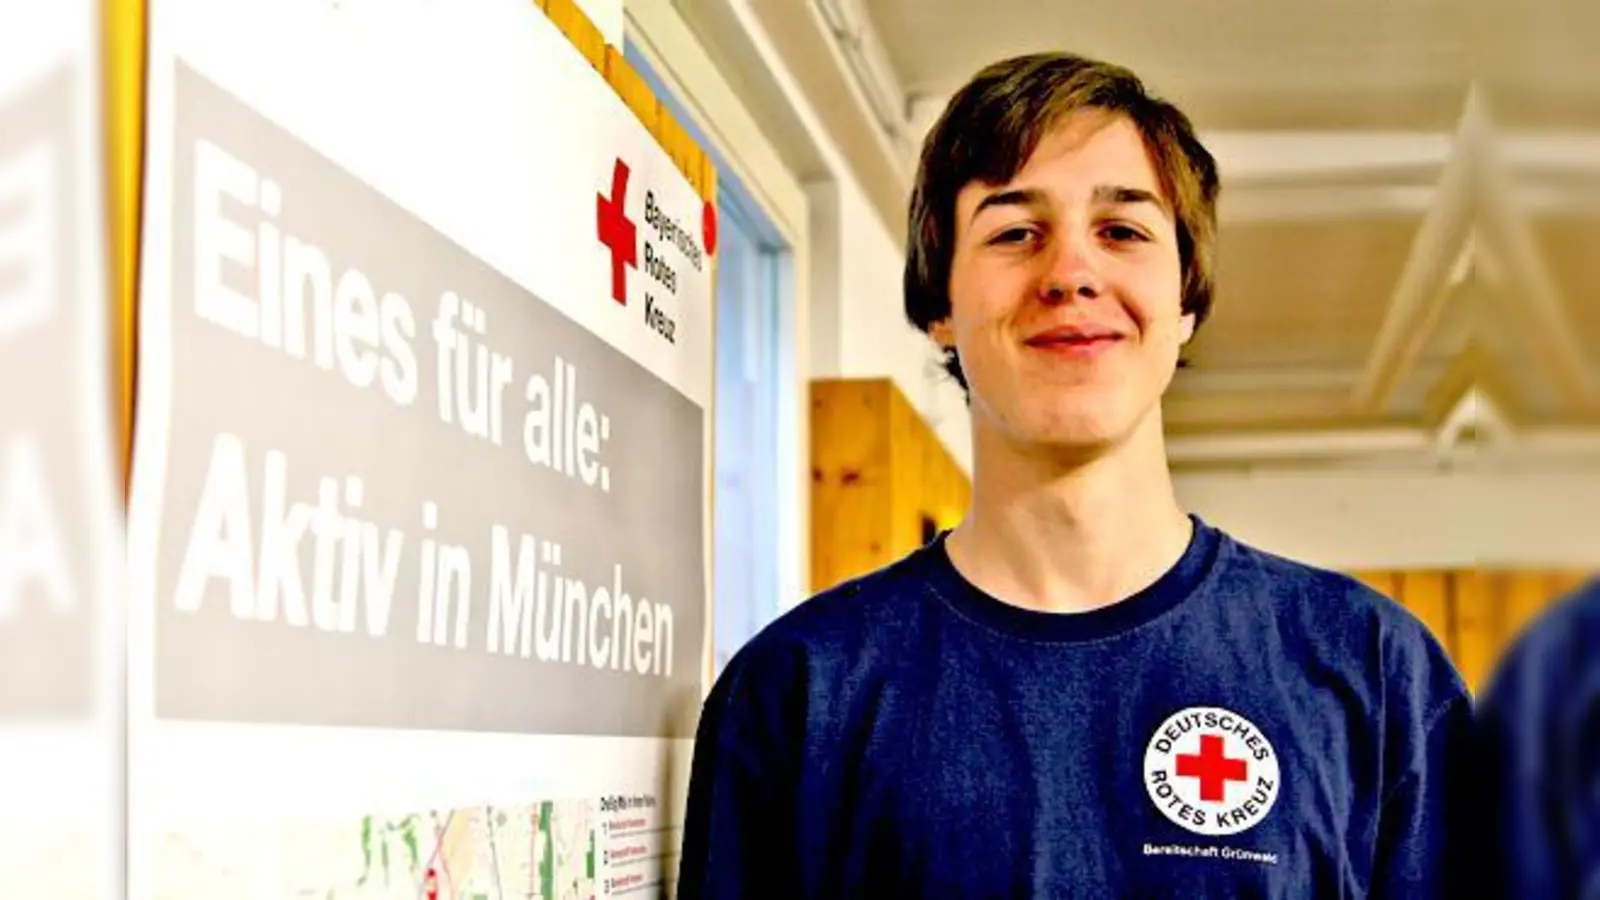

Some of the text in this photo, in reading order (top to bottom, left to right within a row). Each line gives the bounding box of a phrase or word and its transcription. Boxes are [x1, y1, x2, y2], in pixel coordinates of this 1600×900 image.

[645, 189, 702, 272] Bayerisches
[645, 240, 676, 295] Rotes
[194, 138, 418, 407] Eines
[432, 290, 513, 447] für
[524, 356, 611, 492] alle:
[645, 292, 676, 344] Kreuz
[174, 432, 405, 637] Aktiv
[417, 501, 472, 650] in
[486, 524, 674, 678] München
[1155, 712, 1270, 761] DEUTSCHES
[1151, 769, 1274, 828] ROTES KREUZ
[1143, 843, 1278, 865] Bereitschaft Grünwald
